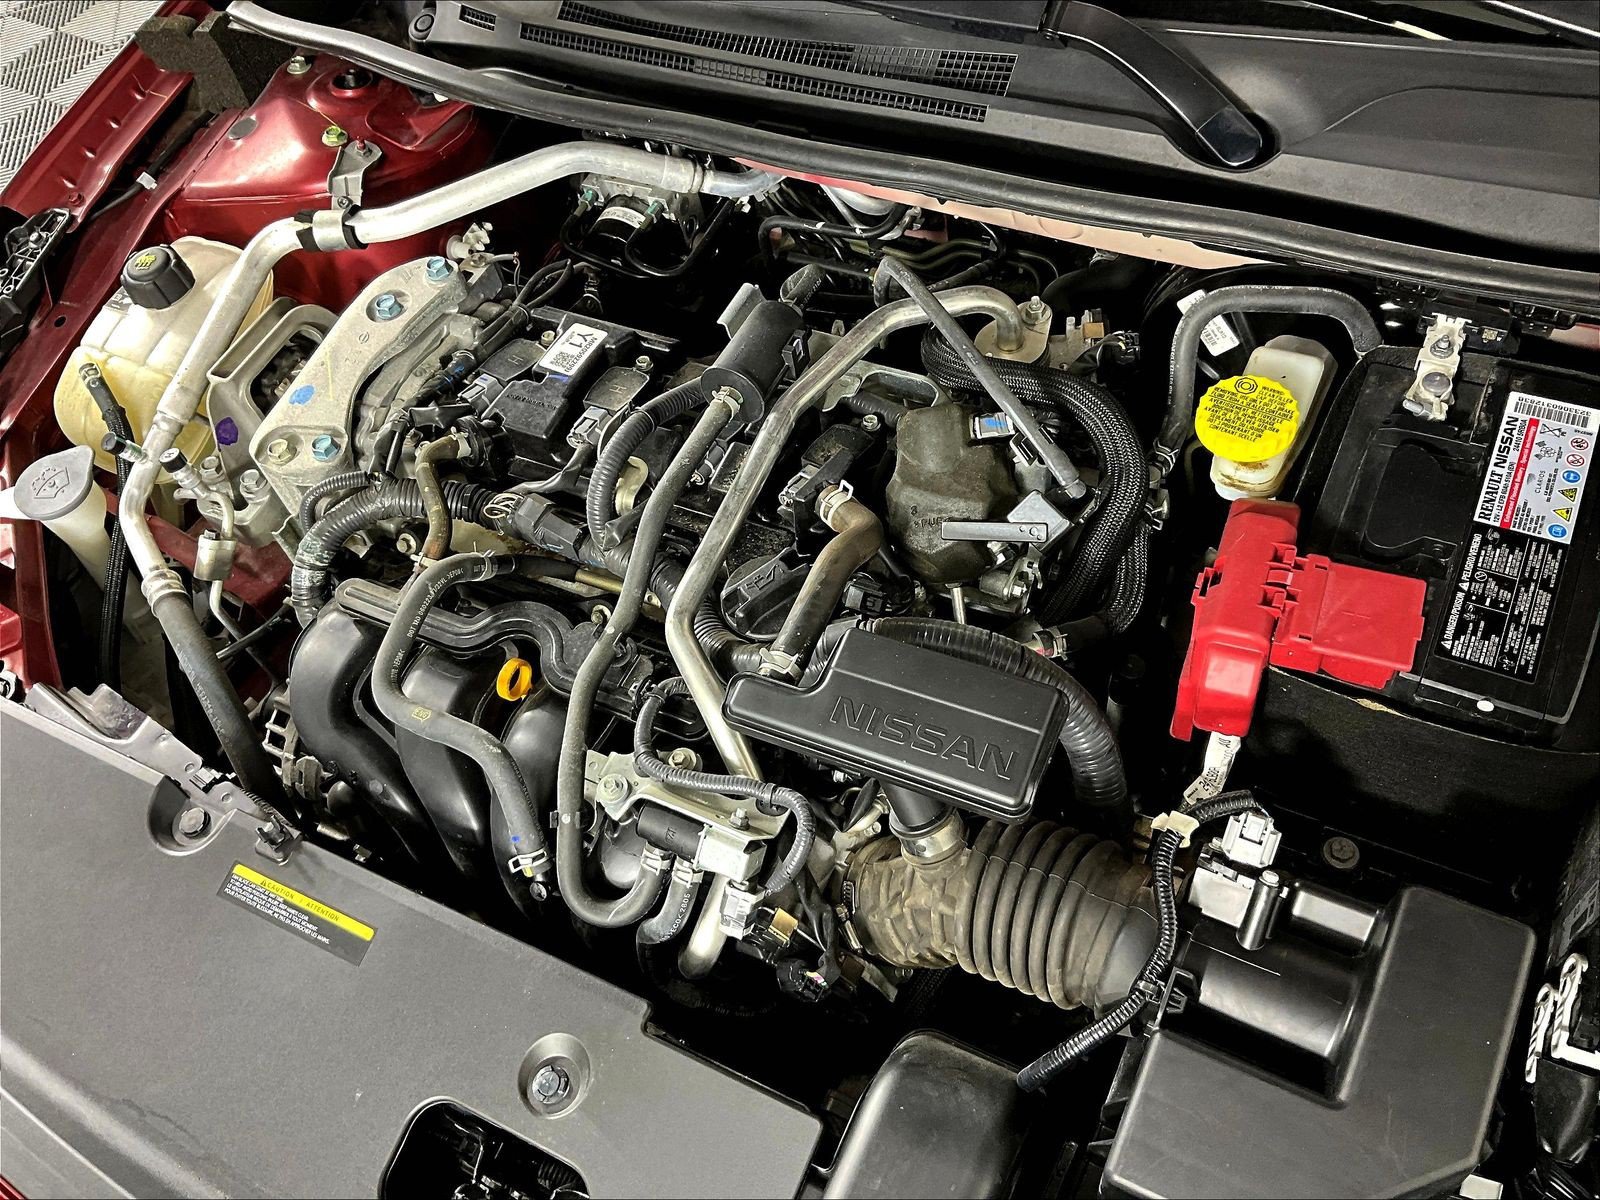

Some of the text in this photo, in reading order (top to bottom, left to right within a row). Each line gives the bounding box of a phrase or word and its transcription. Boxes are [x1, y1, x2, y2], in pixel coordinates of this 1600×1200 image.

[568, 329, 593, 348] Y1
[1477, 469, 1503, 521] RENAULT
[1493, 415, 1518, 468] NISSAN
[1534, 469, 1546, 493] CLARIOS
[1503, 500, 1515, 522] Enhanced
[829, 695, 1019, 781] NISSAN
[266, 882, 295, 899] CAUTION
[305, 901, 339, 921] ATTENTION
